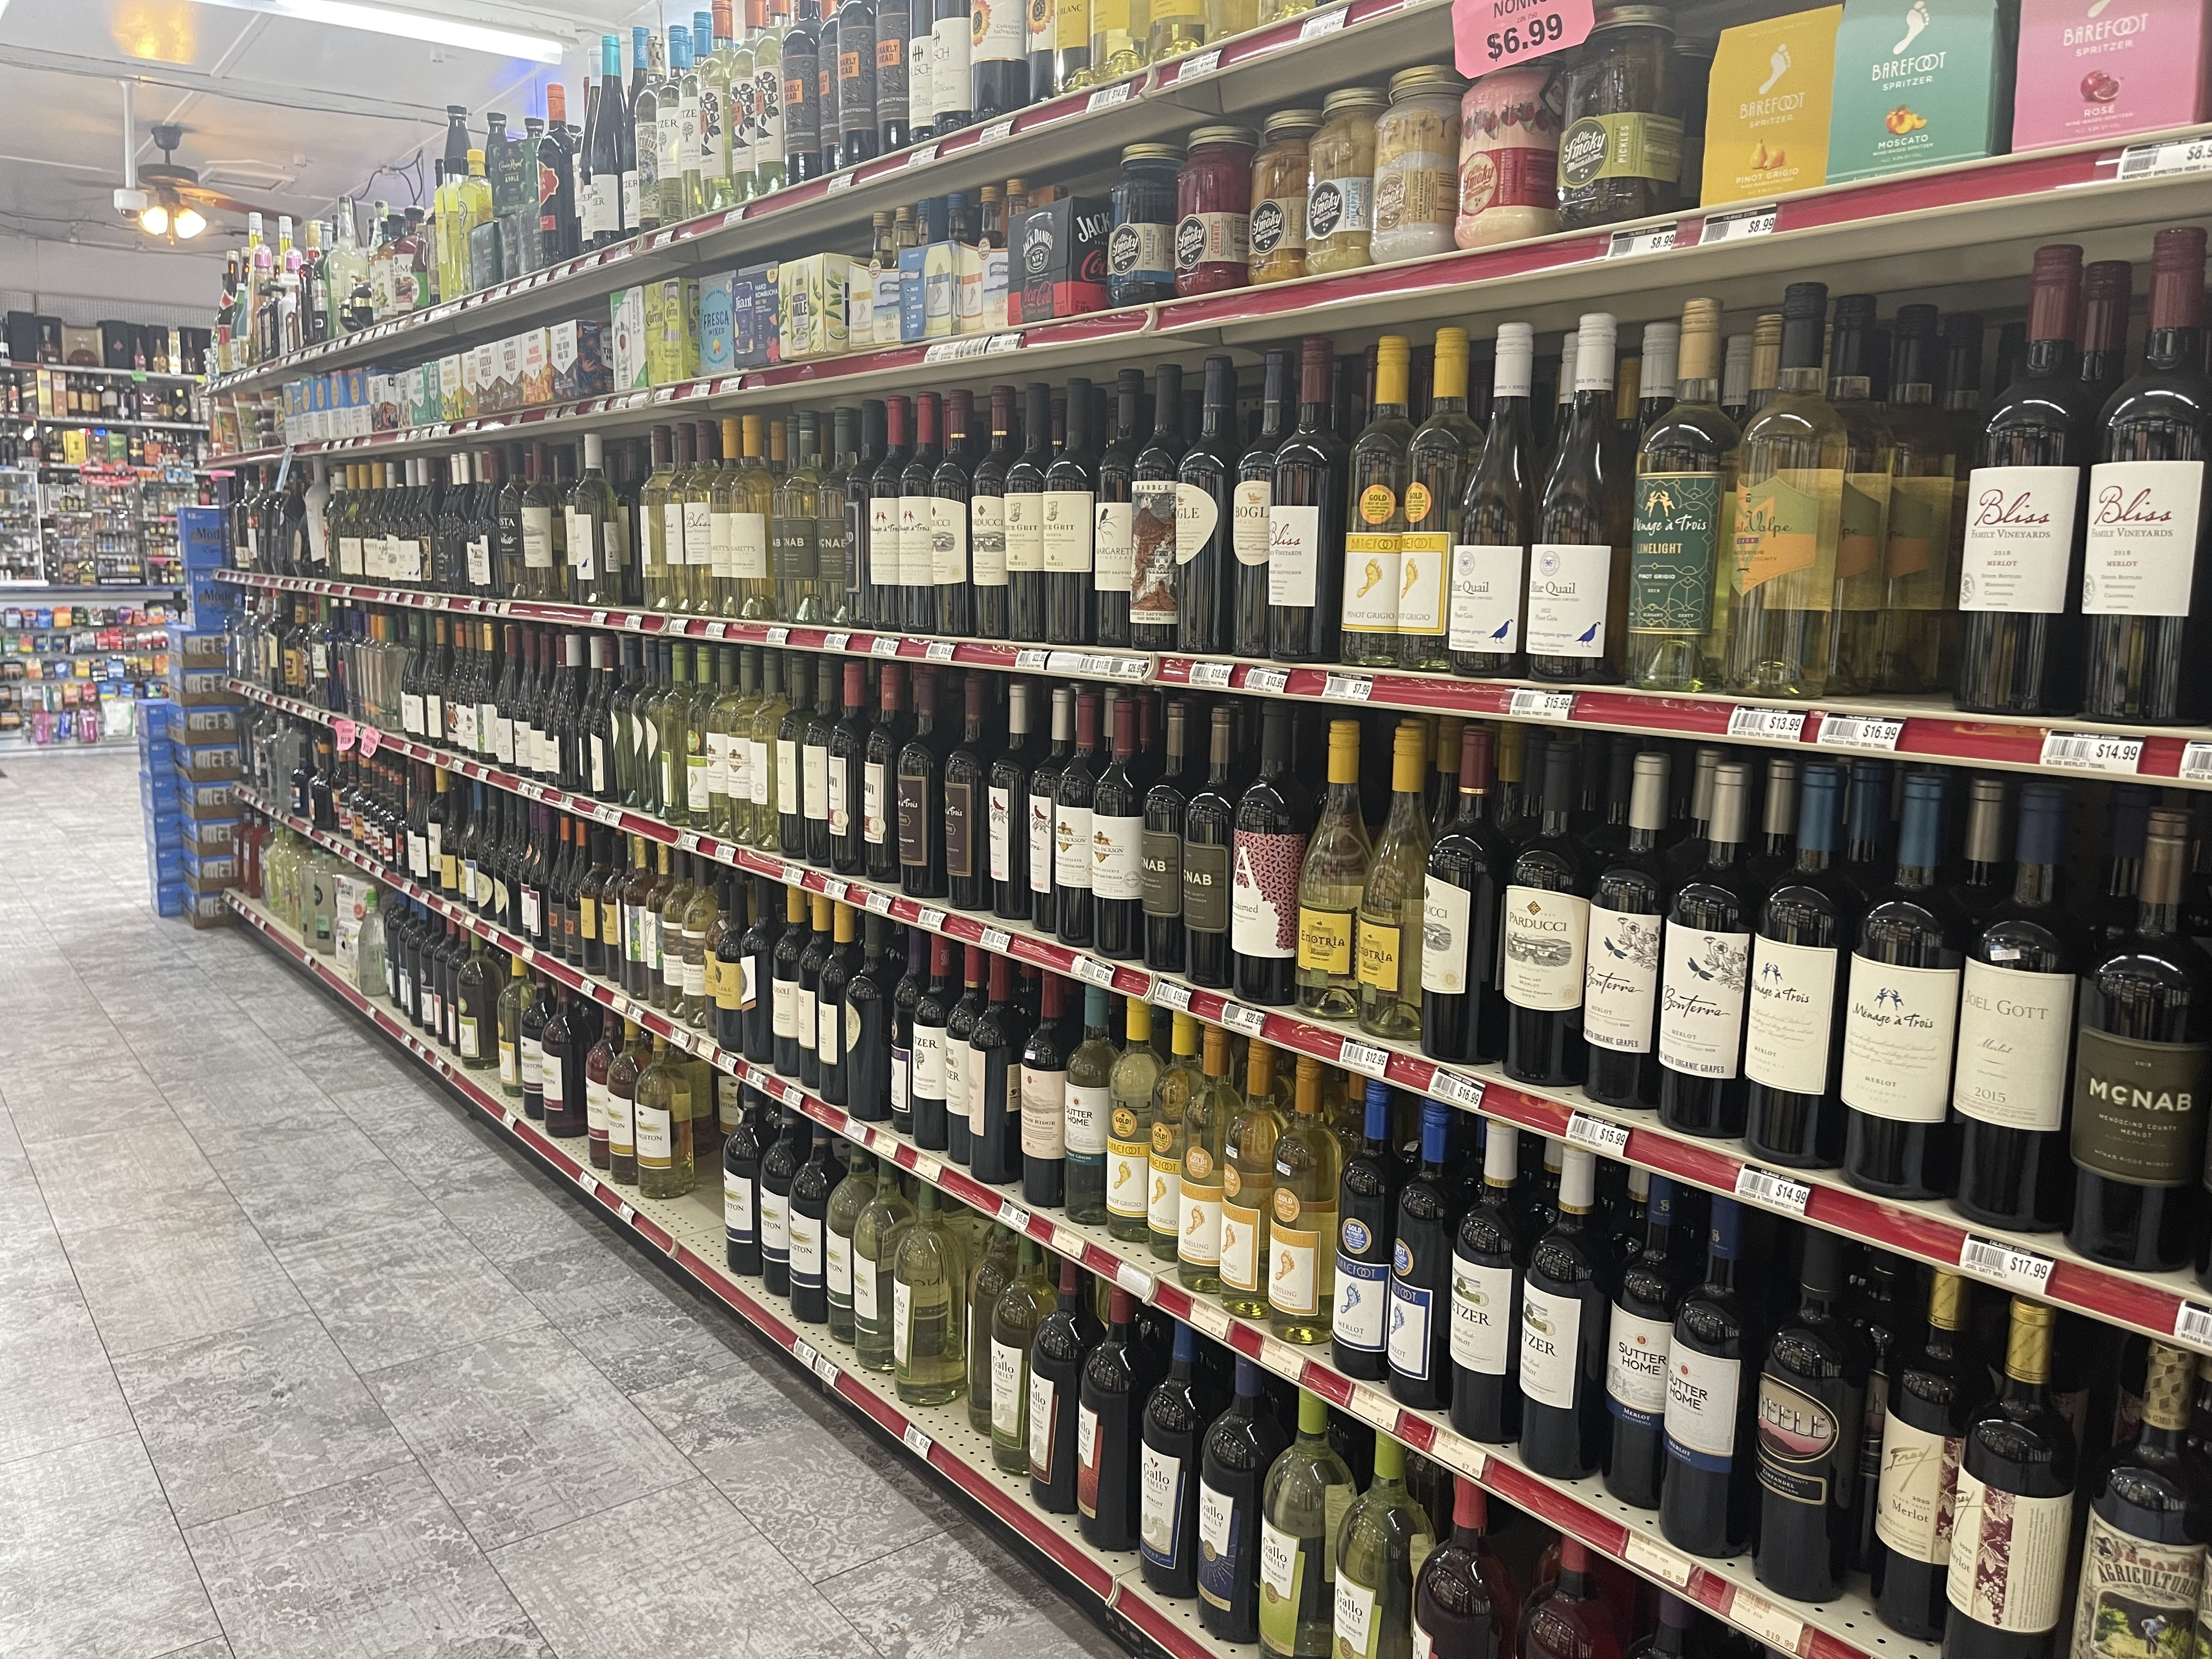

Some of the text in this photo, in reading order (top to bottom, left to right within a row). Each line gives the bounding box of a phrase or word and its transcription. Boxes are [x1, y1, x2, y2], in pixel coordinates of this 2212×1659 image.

[1059, 4, 1083, 14] BLANC
[1487, 13, 1562, 61] $6.99
[2063, 13, 2148, 47] BAREFOOT
[2075, 40, 2133, 57] SPRITZER
[1872, 52, 1946, 81] BAREFOOT
[1882, 76, 1933, 91] SPRITZER
[1740, 92, 1806, 120] BAREFOOT
[1749, 114, 1794, 129] SPRITZER
[1576, 132, 1590, 144] Ole
[1618, 125, 1629, 163] PICKLES
[1878, 134, 1928, 149] MOSCATO
[1563, 132, 1606, 163] Smoky
[505, 174, 519, 183] APPLE
[1736, 167, 1799, 184] PINOT GRIGIO
[1310, 194, 1341, 218] Smoky
[1350, 181, 1358, 227] PINEAPPLES
[1076, 212, 1110, 242] JACK
[1252, 212, 1283, 234] Smoky
[1748, 217, 1774, 233] $8.99
[1178, 227, 1205, 250] Smoky
[1650, 234, 1674, 249] $8.99
[1023, 236, 1034, 258] JACK
[755, 288, 778, 298] KOMBUCHA
[735, 295, 753, 312] Jiant
[792, 301, 808, 318] MULE
[703, 310, 730, 326] FRESCA
[709, 327, 725, 337] MIXED
[1235, 506, 1269, 518] BOGL
[1974, 489, 2051, 527] Bliss
[2094, 486, 2172, 526] Bliss
[1666, 514, 1707, 531] à Trois
[1269, 521, 1301, 546] Bliss
[1997, 529, 2051, 538] VINEYARDS
[2117, 528, 2173, 537] VINEYARDS
[1637, 543, 1683, 554] LIMELIGHT
[1463, 581, 1489, 595] Quail
[1545, 581, 1576, 596] Quail
[1211, 668, 1229, 679] $13.99
[1266, 676, 1284, 689] $13.99
[1353, 683, 1370, 695] $7.99
[1544, 697, 1570, 709] $15.99
[1769, 716, 1801, 731] $13.99
[1863, 725, 1897, 740] $16.99
[2096, 744, 2138, 760] $14.99
[1509, 911, 1567, 932] PARDUCCI
[1096, 968, 1110, 983] $27.99
[1587, 966, 1644, 994] Bonterra
[1173, 990, 1189, 1004] $19.99
[1663, 985, 1730, 1018] Bonterra
[1782, 988, 1810, 1003] Trois
[1965, 990, 2049, 1019] JOEL GOTT
[1245, 1012, 1263, 1026] $22.99
[1852, 1003, 1933, 1029] Ménage à Trois
[1616, 1037, 1638, 1047] GRAPES
[1672, 1029, 1697, 1040] MERLOT
[1754, 1046, 1776, 1057] MERLOT
[1977, 1038, 2012, 1054] Merlot
[1365, 1051, 1385, 1066] $12.99
[1675, 1059, 1725, 1074] ORGANIC GRAPES
[1865, 1075, 1897, 1087] MERLOT
[1458, 1087, 1480, 1105] $16.99
[1974, 1087, 2006, 1103] 2015
[2089, 1077, 2192, 1111] MCNAB
[1066, 1105, 1093, 1119] SUTTER
[1067, 1115, 1089, 1126] HOME
[1599, 1127, 1626, 1146] $15.99
[2120, 1128, 2152, 1138] MERLOT
[1189, 1155, 1207, 1165] GOLD!
[1225, 1171, 1235, 1180] GOLD
[1278, 1195, 1293, 1203] GOLD
[1776, 1184, 1808, 1204] $14.99
[1156, 1216, 1176, 1226] GRIGIO
[1348, 1224, 1362, 1233] GOLD
[1184, 1239, 1209, 1249] RIESLING
[1396, 1244, 1406, 1255] BEST
[2010, 1257, 2047, 1279] $17.99
[1210, 1326, 1224, 1338] $7.99
[1338, 1320, 1364, 1334] MERLOT
[1618, 1341, 1666, 1365] SUTTER
[992, 1355, 1014, 1373] Gallo
[1622, 1356, 1660, 1375] HOME
[992, 1366, 1013, 1380] FAMILY
[1284, 1367, 1298, 1378] $7.99
[1669, 1370, 1708, 1401] SUTTER
[1670, 1387, 1702, 1410] HOME
[1623, 1407, 1651, 1421] MERLOT
[1376, 1418, 1393, 1430] $7.99
[1669, 1439, 1691, 1456] MERLOT
[1143, 1462, 1170, 1485] Gallo
[1462, 1463, 1480, 1477] $7.99
[1762, 1467, 1795, 1489] ZINFANDEL
[1144, 1475, 1169, 1492] FAMILY
[1146, 1494, 1163, 1506] MERLOT
[1912, 1496, 1930, 1505] 2020
[1201, 1497, 1224, 1521] Gallo
[1892, 1499, 1928, 1523] Merlot
[1201, 1508, 1222, 1528] FAMILY
[1262, 1536, 1288, 1564] Gallo
[1263, 1551, 1286, 1570] FAMILY
[1662, 1569, 1685, 1584] $5.99
[1337, 1588, 1363, 1617] Gallo
[1337, 1602, 1362, 1624] FAMILY
[1765, 1630, 1795, 1650] $19.99
